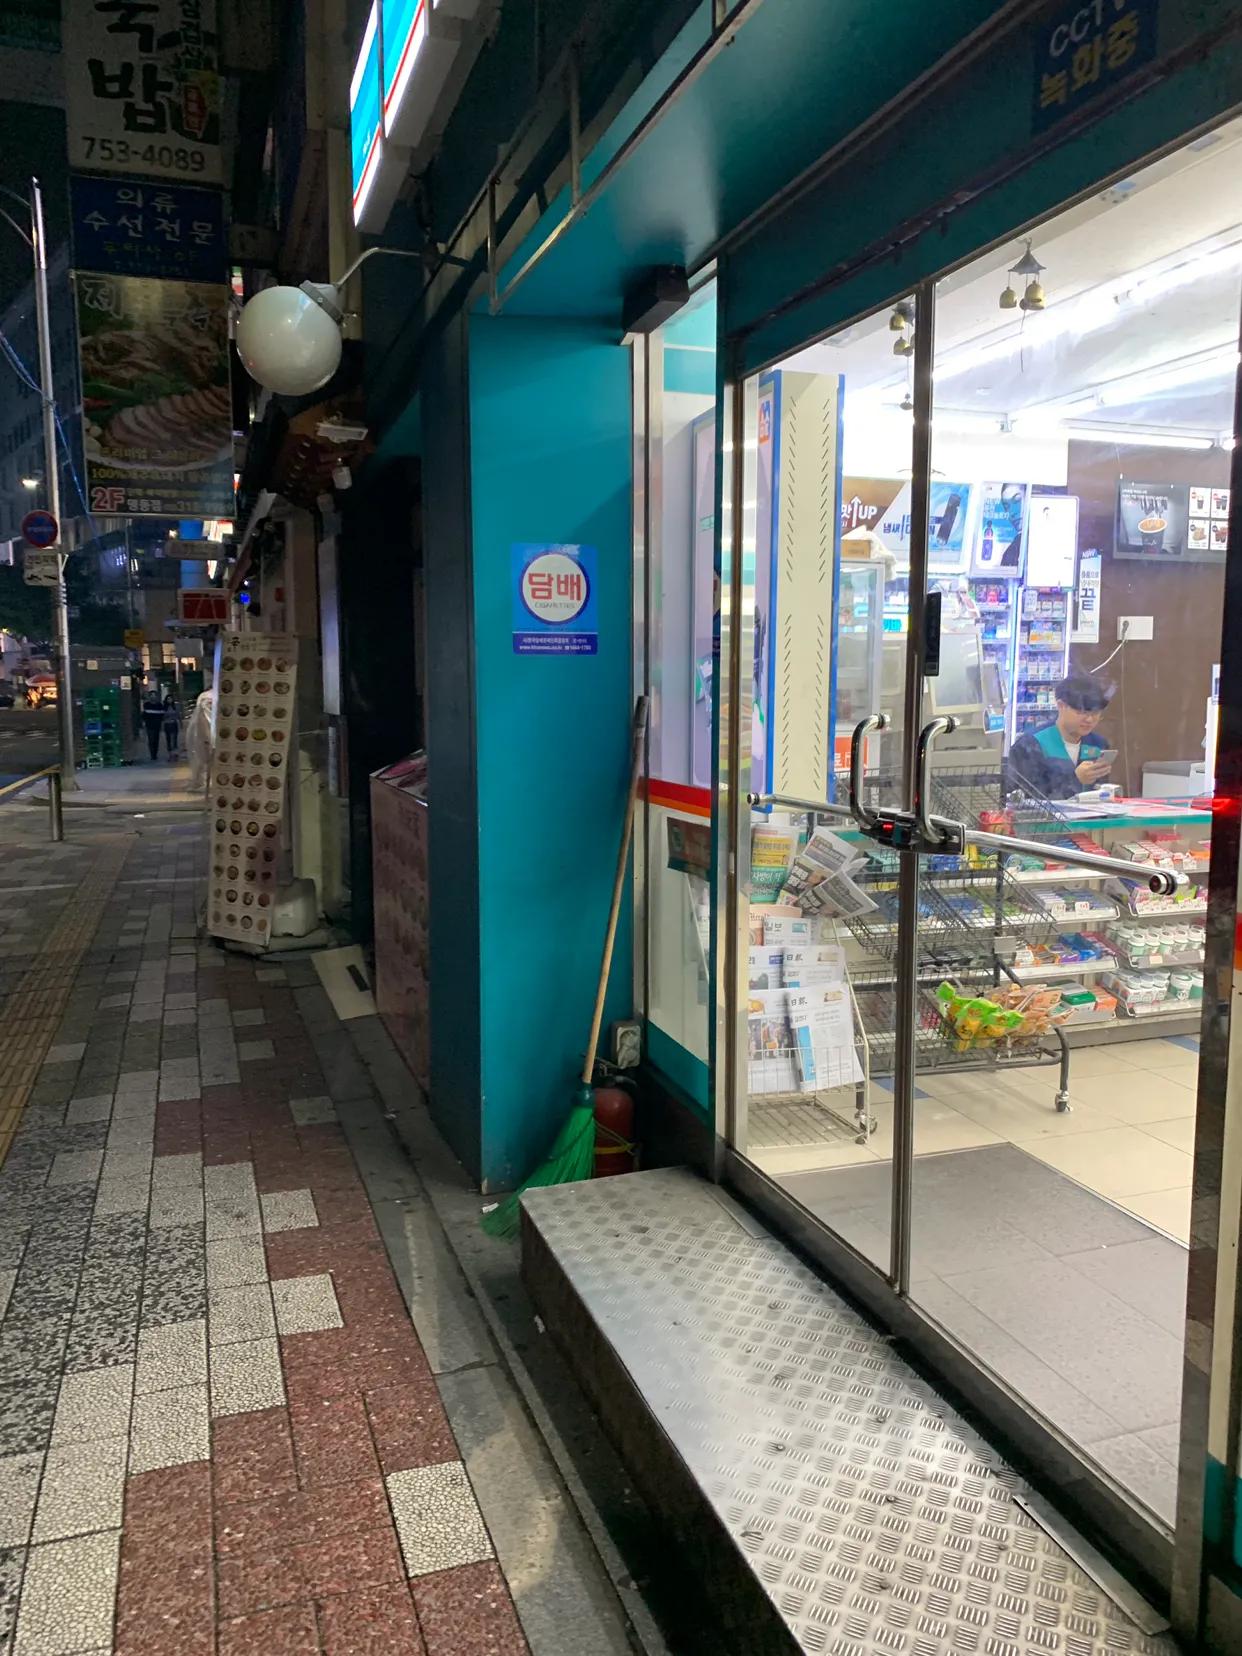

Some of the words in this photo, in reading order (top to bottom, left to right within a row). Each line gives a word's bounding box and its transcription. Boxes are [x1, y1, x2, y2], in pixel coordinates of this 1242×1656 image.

[1049, 0, 1126, 57] CCT
[1039, 10, 1139, 109] 녹화중
[81, 136, 206, 173] 753-4089
[114, 187, 180, 215] 의류
[90, 486, 126, 512] 2F
[858, 505, 878, 519] UP
[528, 572, 582, 601] 담배
[1080, 587, 1097, 611] 끝
